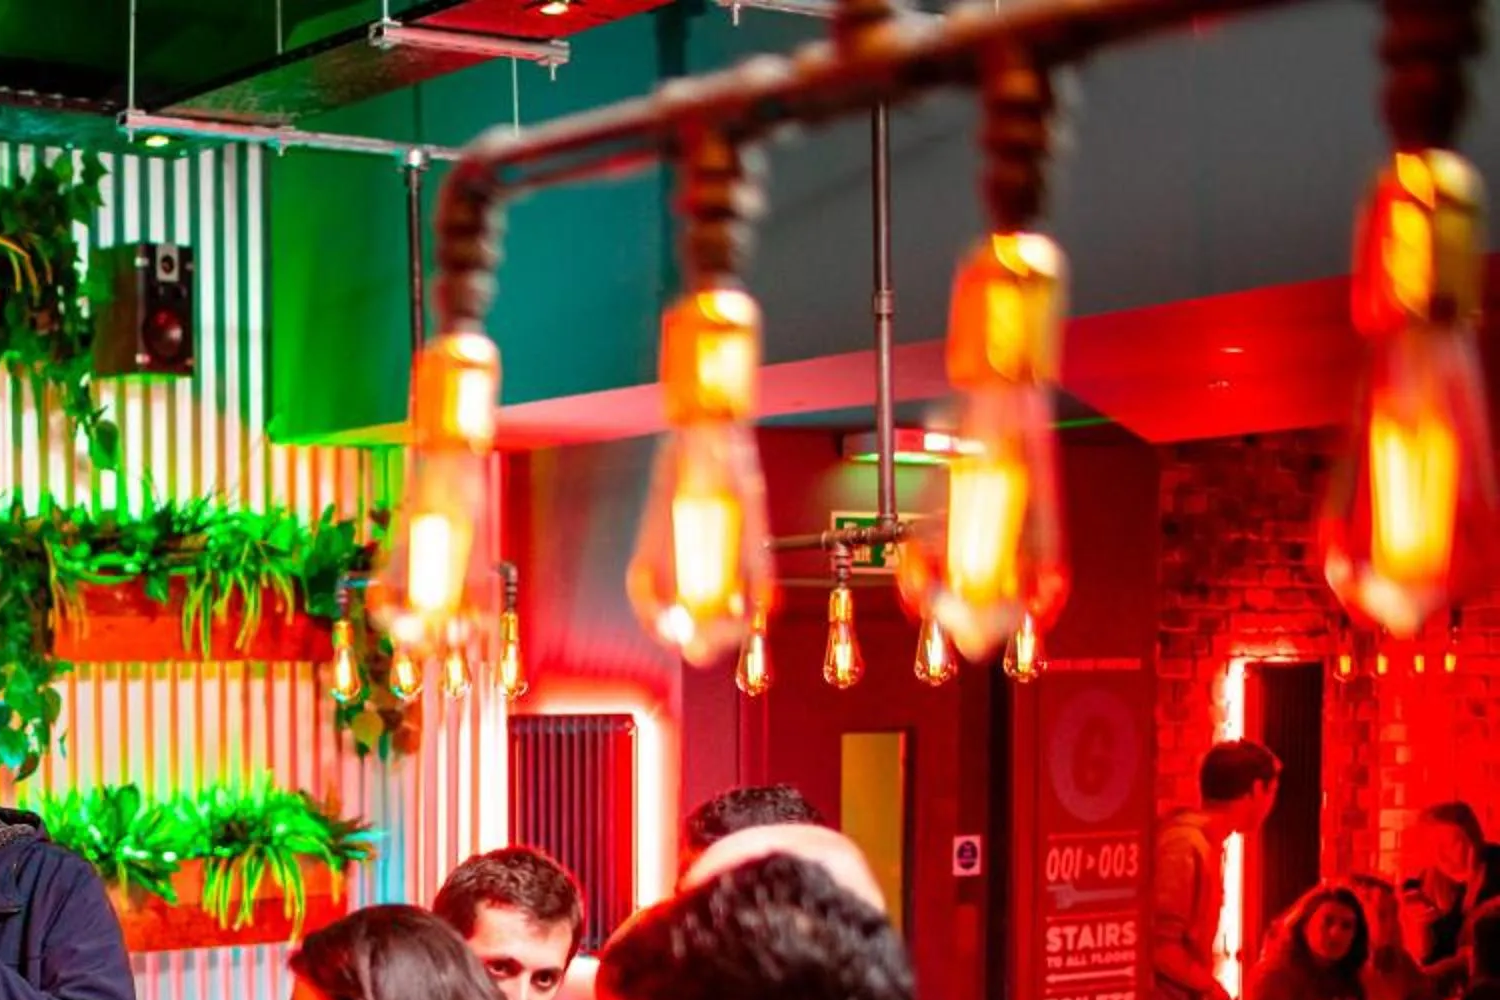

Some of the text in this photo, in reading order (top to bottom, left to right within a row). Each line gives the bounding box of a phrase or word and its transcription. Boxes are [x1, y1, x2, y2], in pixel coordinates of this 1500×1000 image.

[1046, 843, 1139, 882] 001 003
[1046, 921, 1137, 953] STAIRS
[1066, 954, 1088, 967] ALL
